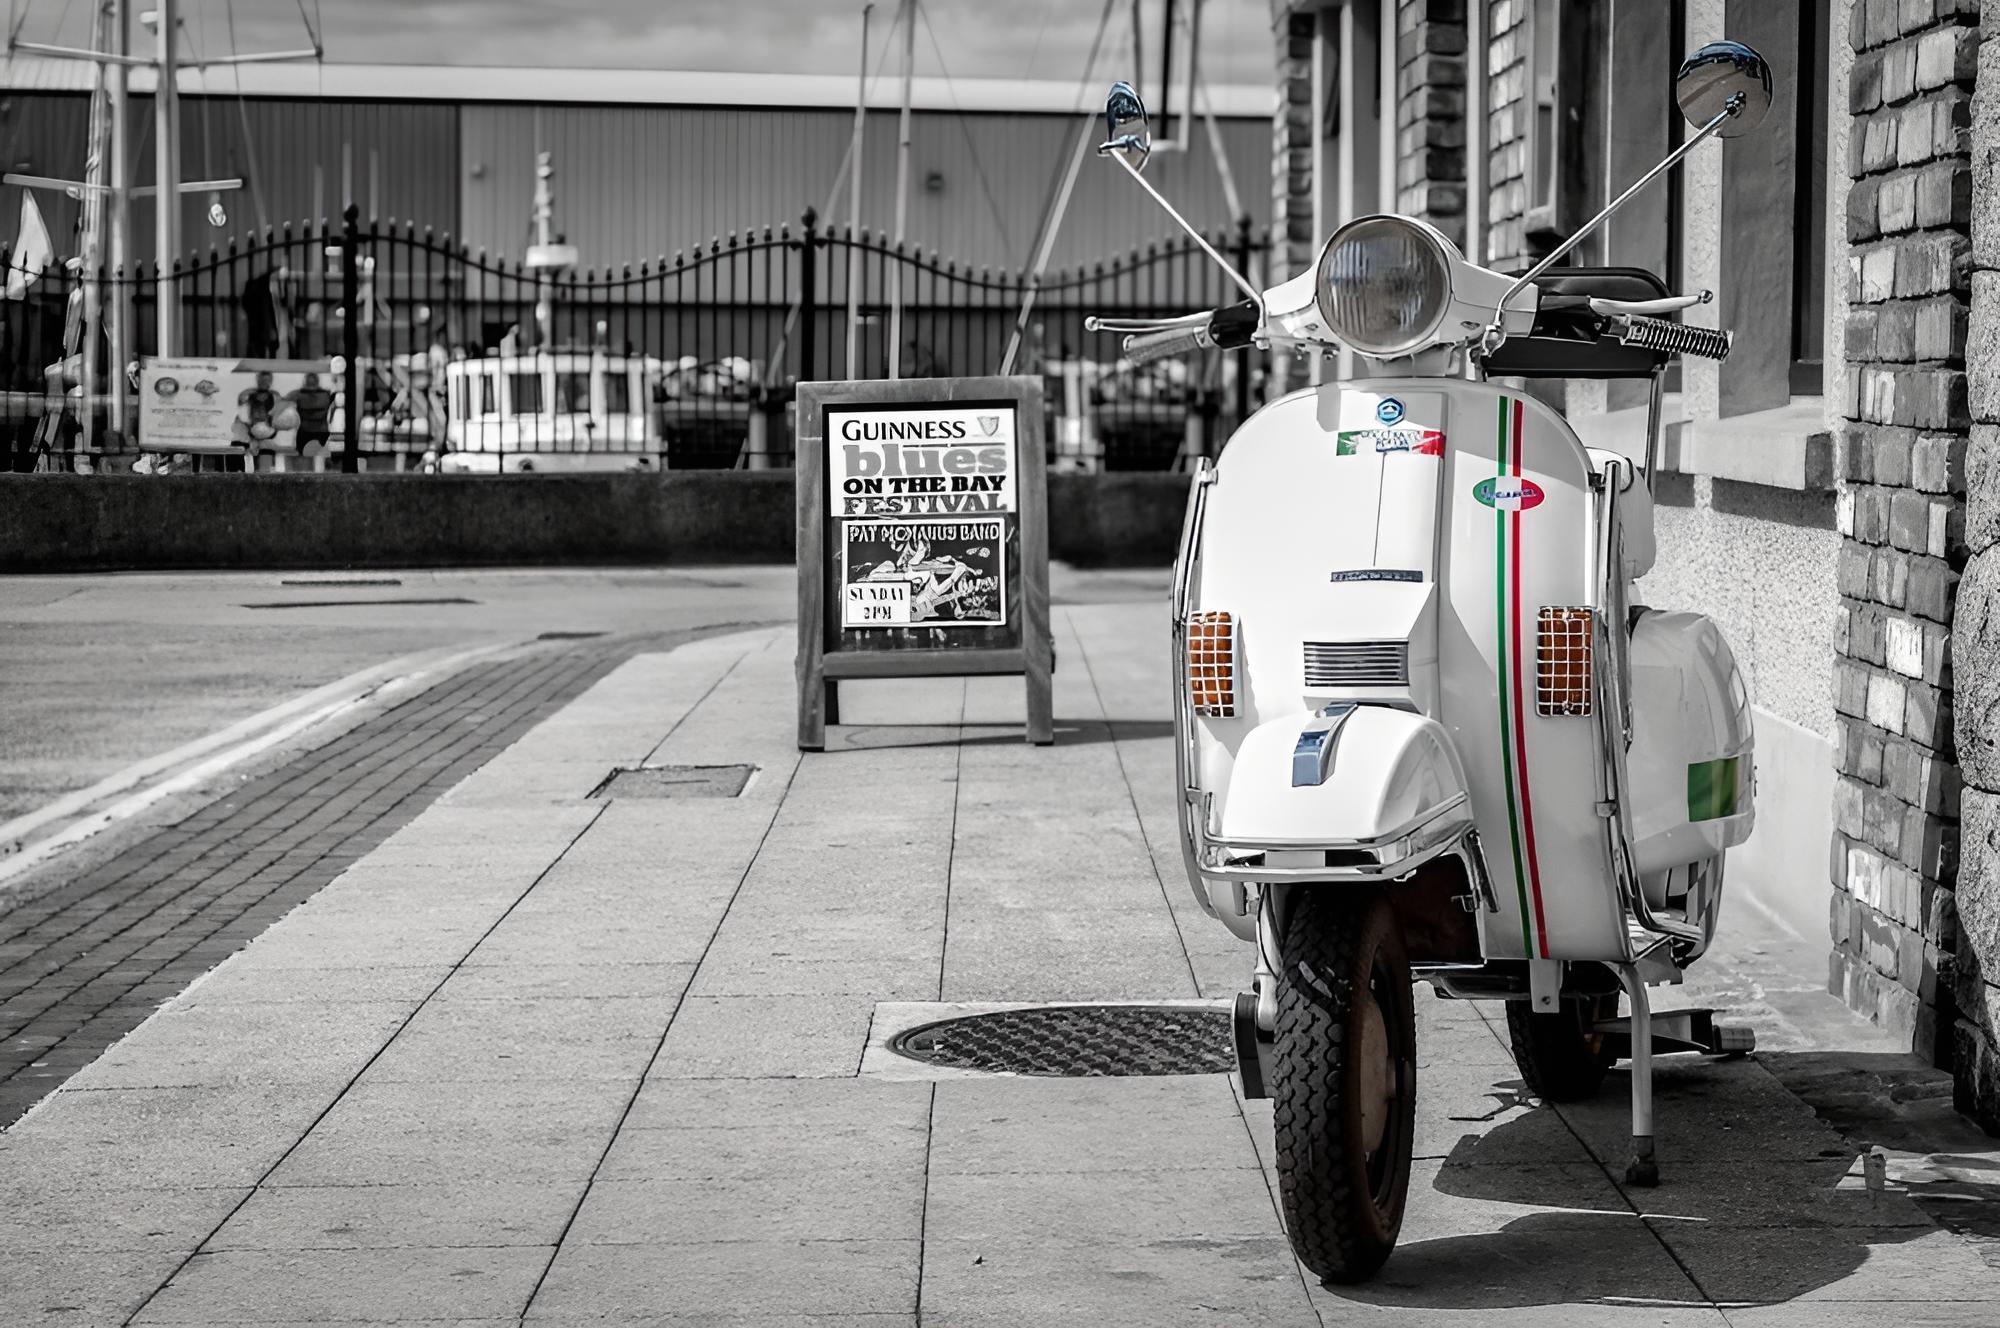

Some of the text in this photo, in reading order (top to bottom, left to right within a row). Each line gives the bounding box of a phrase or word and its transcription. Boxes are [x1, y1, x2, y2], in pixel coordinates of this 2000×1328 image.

[841, 420, 966, 441] GUINNESS
[843, 443, 1007, 477] blues
[843, 475, 1006, 494] ON THE BAY
[843, 493, 1007, 515] FESTIVAL
[849, 526, 877, 542] PAT
[960, 524, 999, 540] BAND
[849, 587, 904, 601] SUNDAY
